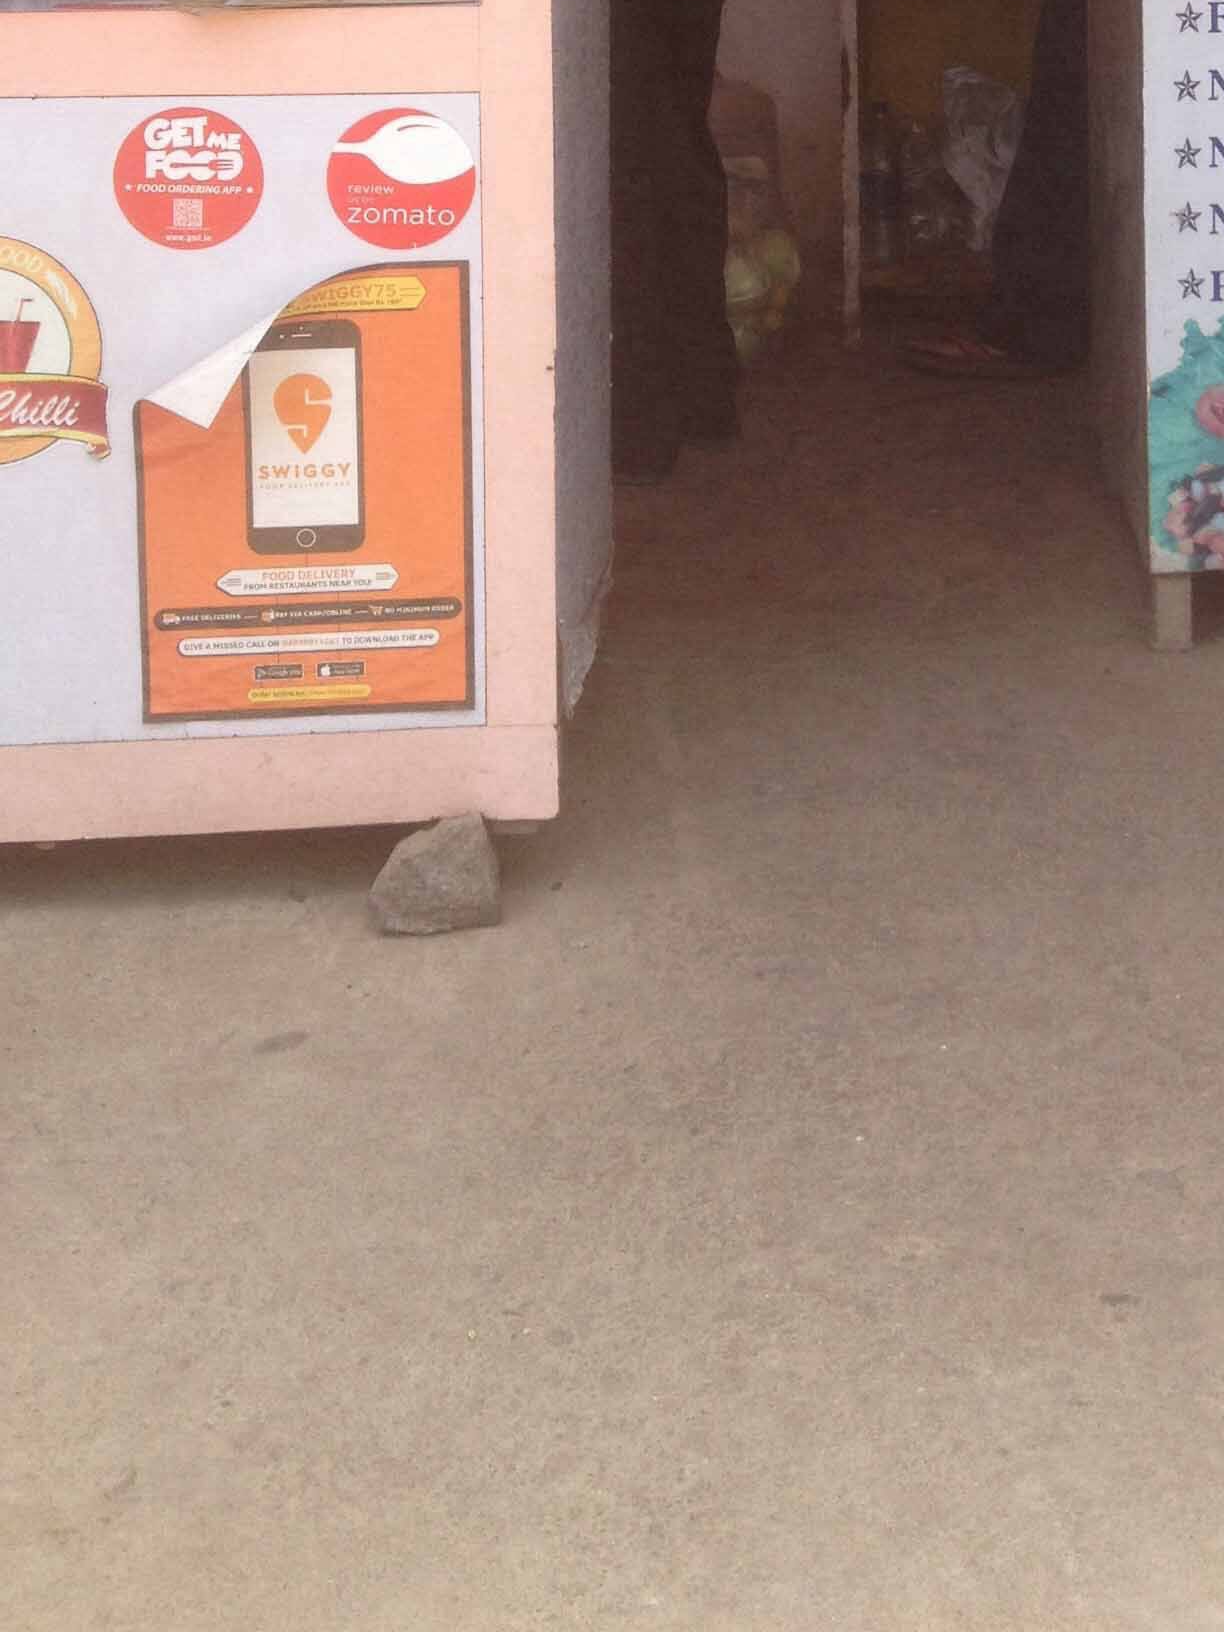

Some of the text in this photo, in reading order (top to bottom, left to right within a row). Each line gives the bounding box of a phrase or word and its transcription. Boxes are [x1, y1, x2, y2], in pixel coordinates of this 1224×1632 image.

[143, 116, 242, 151] GET ME
[136, 183, 242, 195] FOOD ORDERING APP
[347, 183, 395, 194] review
[347, 203, 456, 226] zomato
[258, 462, 352, 480] SWIGGY
[261, 567, 356, 581] FOOD DELIVERY
[243, 581, 268, 591] FROM
[183, 643, 203, 652] GIVE
[213, 641, 244, 651] MISSED
[246, 640, 265, 650] CALL
[342, 636, 352, 646] TO
[353, 634, 400, 645] DOWNLOAD
[401, 633, 417, 643] THE
